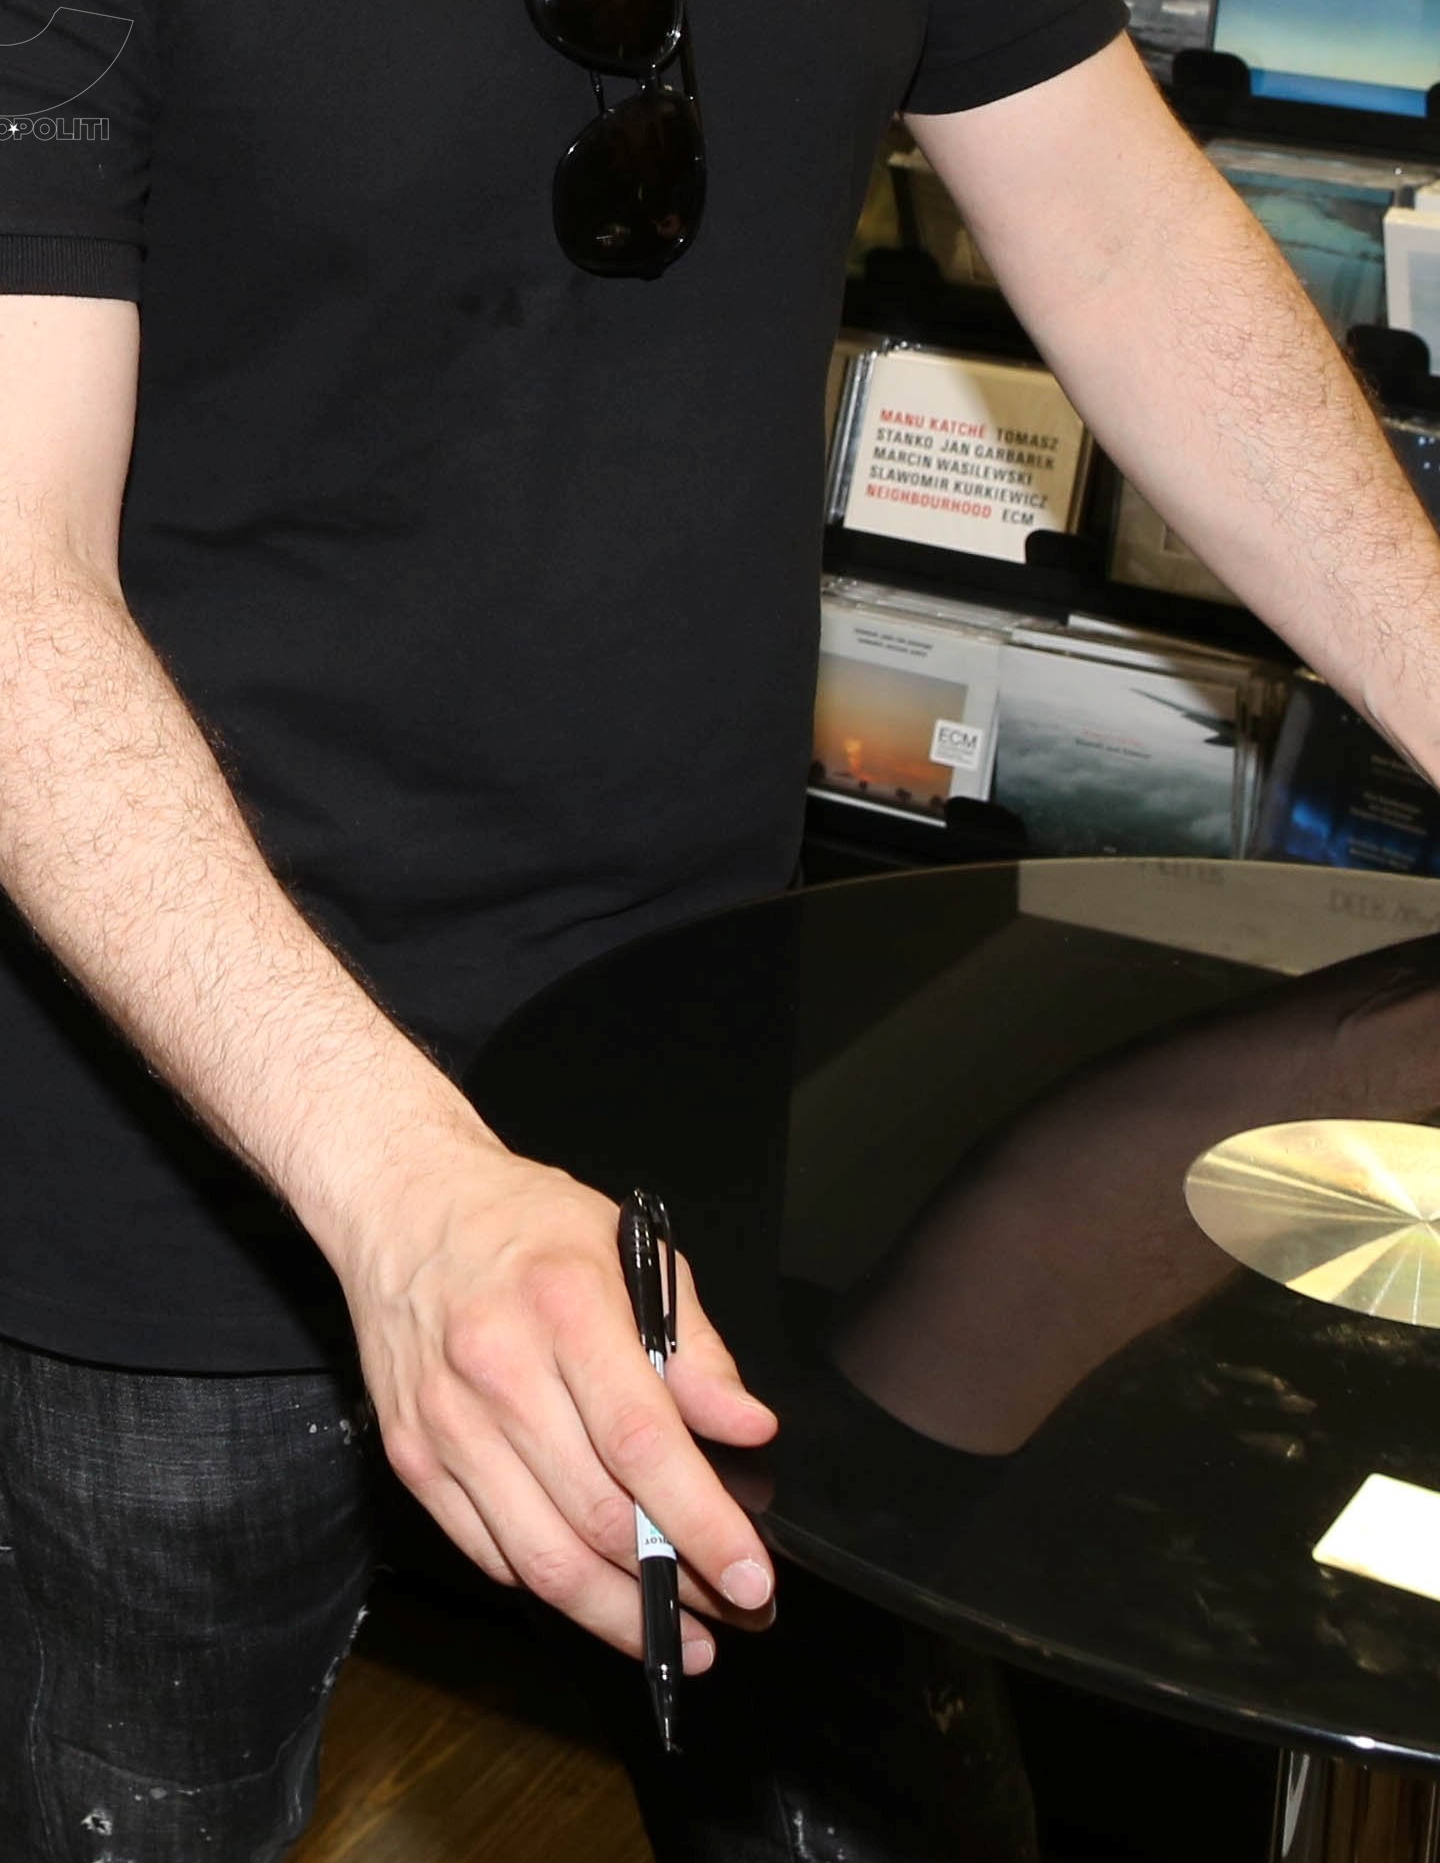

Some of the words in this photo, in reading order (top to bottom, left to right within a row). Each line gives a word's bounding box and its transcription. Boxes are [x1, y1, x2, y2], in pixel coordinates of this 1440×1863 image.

[877, 427, 934, 450] STANKO
[939, 438, 970, 457] JAN
[974, 444, 1055, 470] GARBAREK
[880, 409, 926, 429] MANU
[996, 427, 1059, 451] TOMASZ
[869, 465, 950, 489] SLAWOMIR
[953, 481, 1049, 509] KURKIEWICZ
[873, 446, 933, 468] MARCIN
[936, 458, 1033, 486] WASILEWSKI
[865, 483, 993, 519] NEIGHBOURHOOD
[1001, 508, 1035, 526] ECM
[938, 727, 978, 749] ECM
